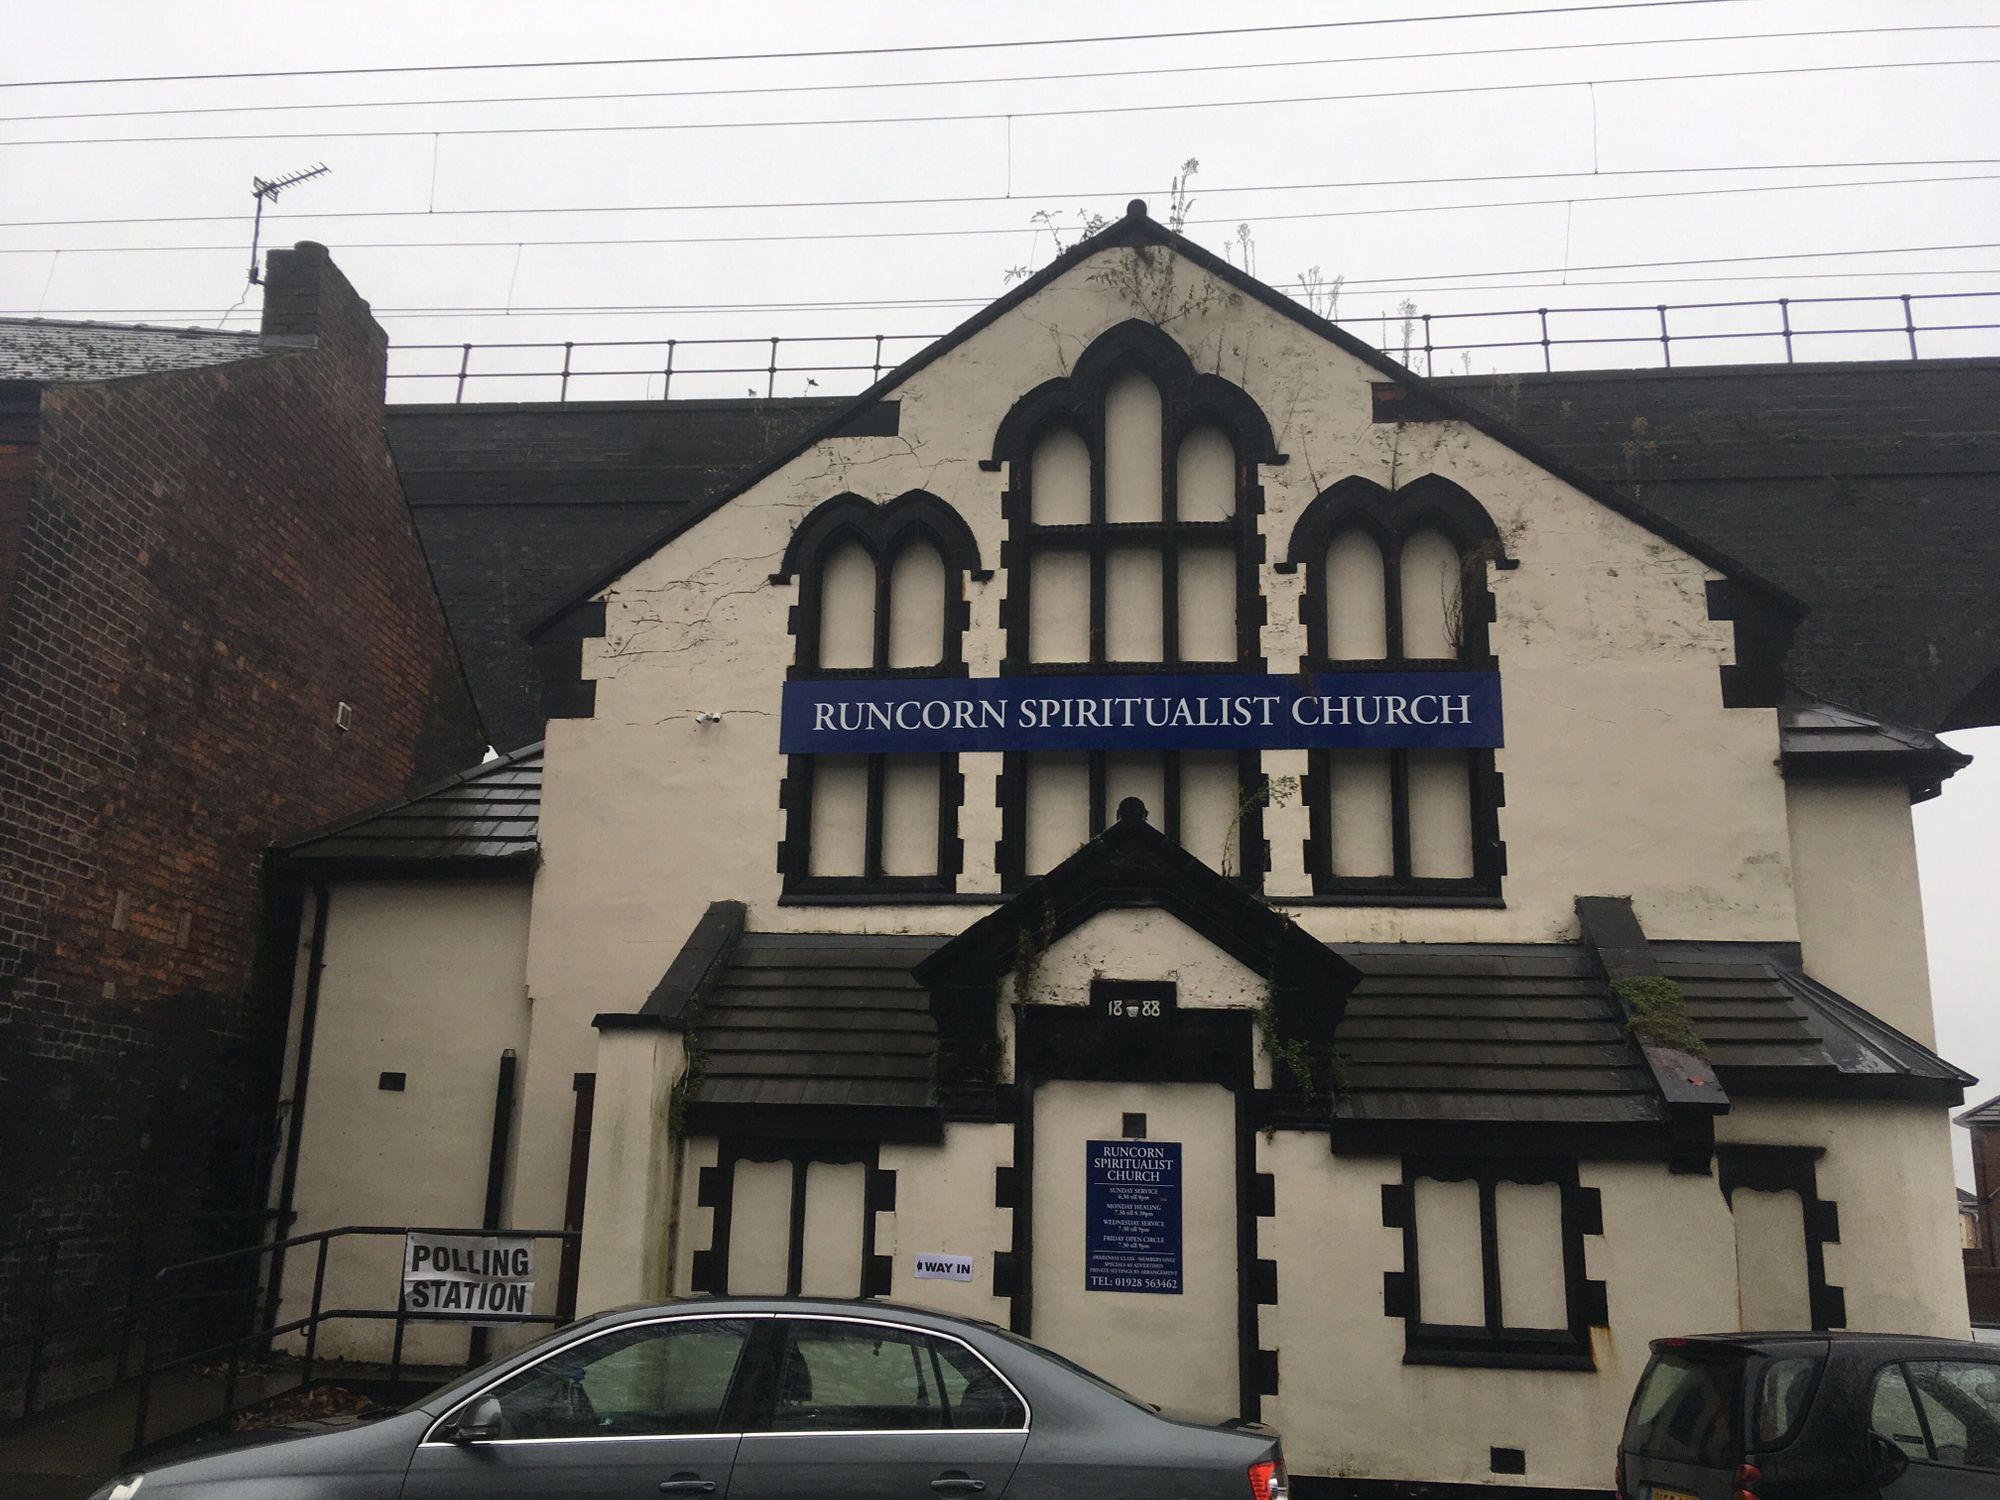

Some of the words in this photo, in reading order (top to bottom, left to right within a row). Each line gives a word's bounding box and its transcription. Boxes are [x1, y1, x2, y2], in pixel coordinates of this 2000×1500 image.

[812, 699, 1009, 731] RUNCORN
[1018, 696, 1280, 728] SPIRITUALIST
[1291, 694, 1473, 726] CHURCH
[1103, 1147, 1164, 1158] RUNCORN
[1094, 1158, 1174, 1170] SPIRITUALIST
[1107, 1170, 1160, 1182] CHURCH
[411, 1245, 529, 1276] POLLING
[924, 1262, 954, 1273] WAY
[956, 1264, 971, 1274] IN
[1090, 1276, 1113, 1286] TEL:
[1114, 1277, 1143, 1287] 01928
[1145, 1278, 1178, 1289] 563462
[412, 1280, 527, 1312] STATION
